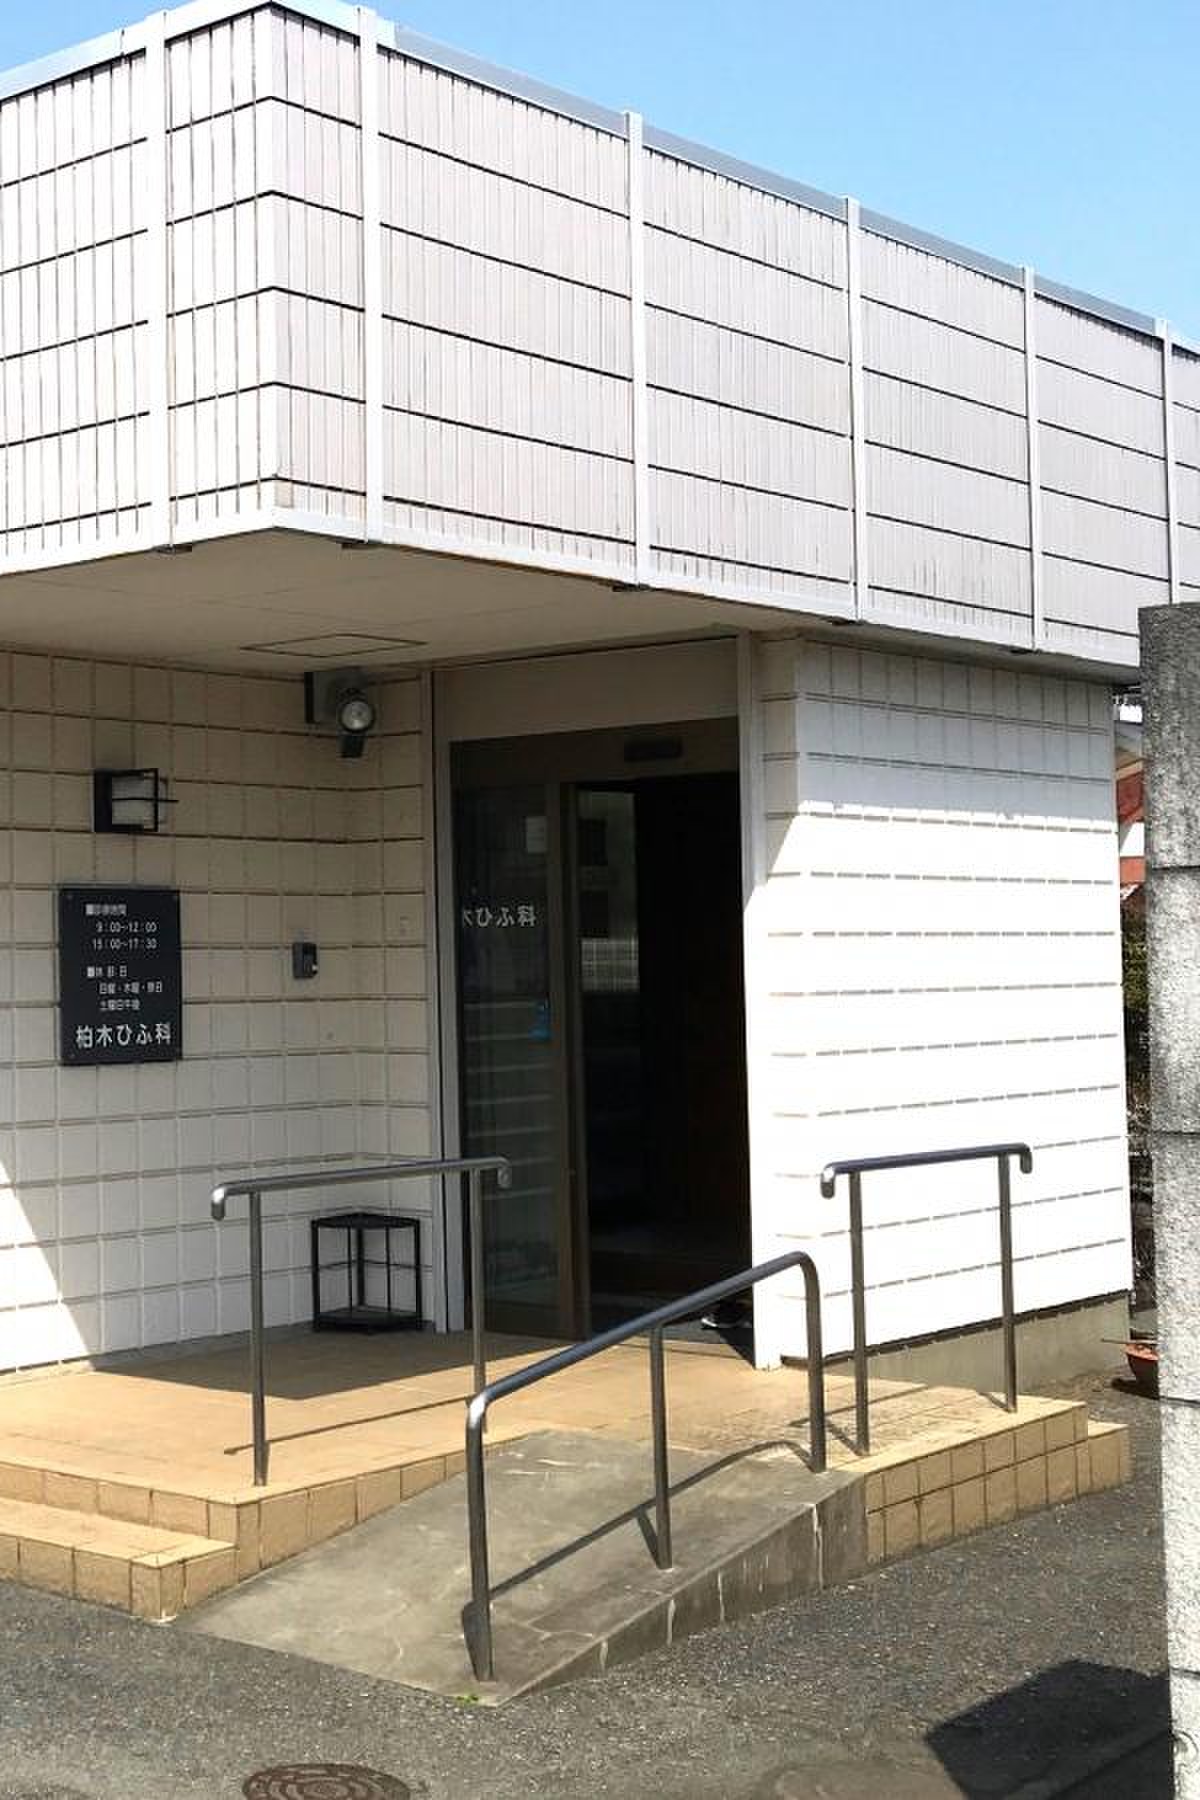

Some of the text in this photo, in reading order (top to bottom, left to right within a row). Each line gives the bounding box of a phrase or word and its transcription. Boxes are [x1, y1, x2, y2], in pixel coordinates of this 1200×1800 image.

[76, 1022, 171, 1049] 柏木ひふ科
